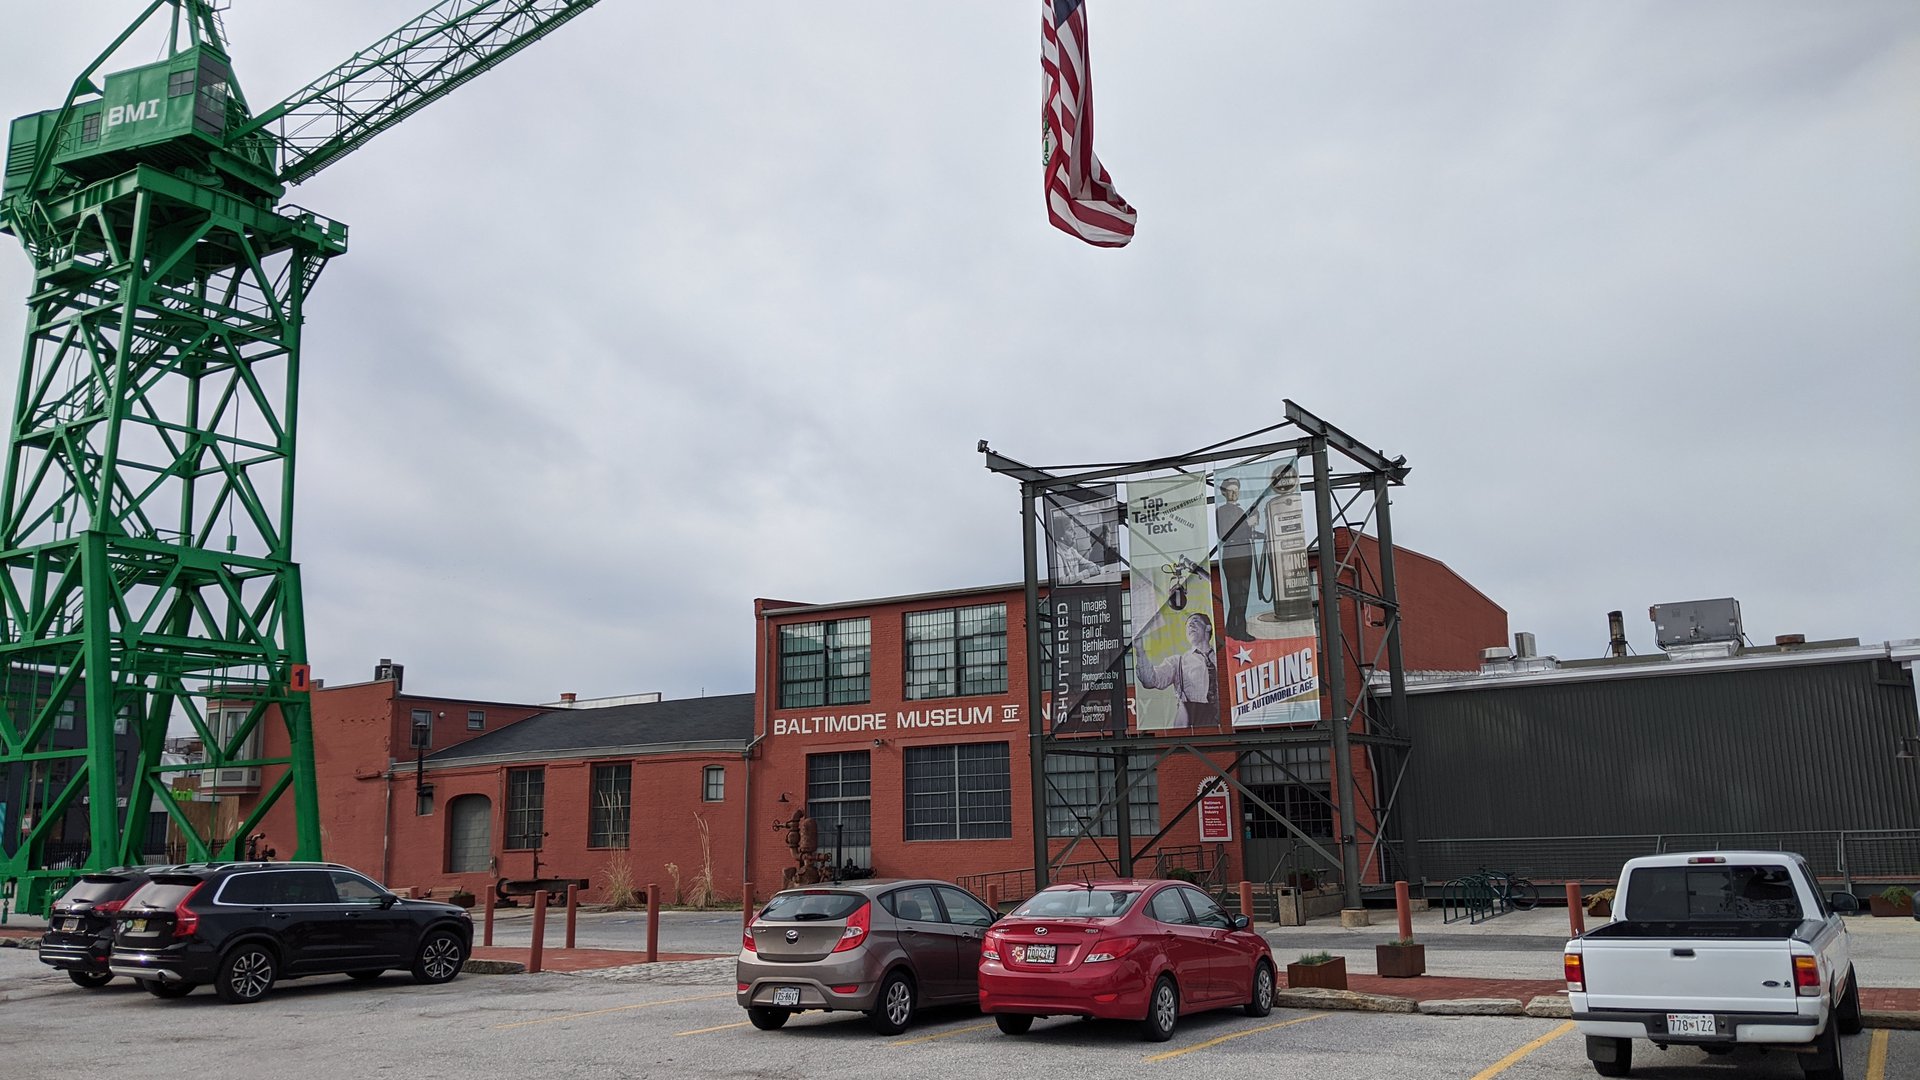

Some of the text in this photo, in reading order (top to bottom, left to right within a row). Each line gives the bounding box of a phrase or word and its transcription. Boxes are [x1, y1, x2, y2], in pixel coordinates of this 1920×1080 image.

[108, 99, 160, 127] BMI
[1140, 496, 1168, 511] Tap.
[1132, 509, 1166, 523] Talk.
[1145, 521, 1177, 535] Text.
[1081, 600, 1107, 612] Images
[1082, 611, 1111, 625] from the
[1082, 625, 1103, 639] Fall of
[1083, 638, 1119, 652] Bethlehem
[1057, 602, 1070, 723] SHUTTERED
[1082, 652, 1100, 666] Steel
[295, 669, 304, 687] 1
[1081, 670, 1119, 682] Photographs by
[1235, 647, 1313, 705] FUELING
[1237, 680, 1314, 716] THE AUTOMOBILE AGE
[1081, 703, 1112, 714] Open through
[773, 713, 887, 736] BALTIMORE
[897, 705, 993, 729] MUSEUM
[1003, 707, 1019, 719] OF
[1082, 713, 1092, 723] April
[1670, 1019, 1689, 1031] 778
